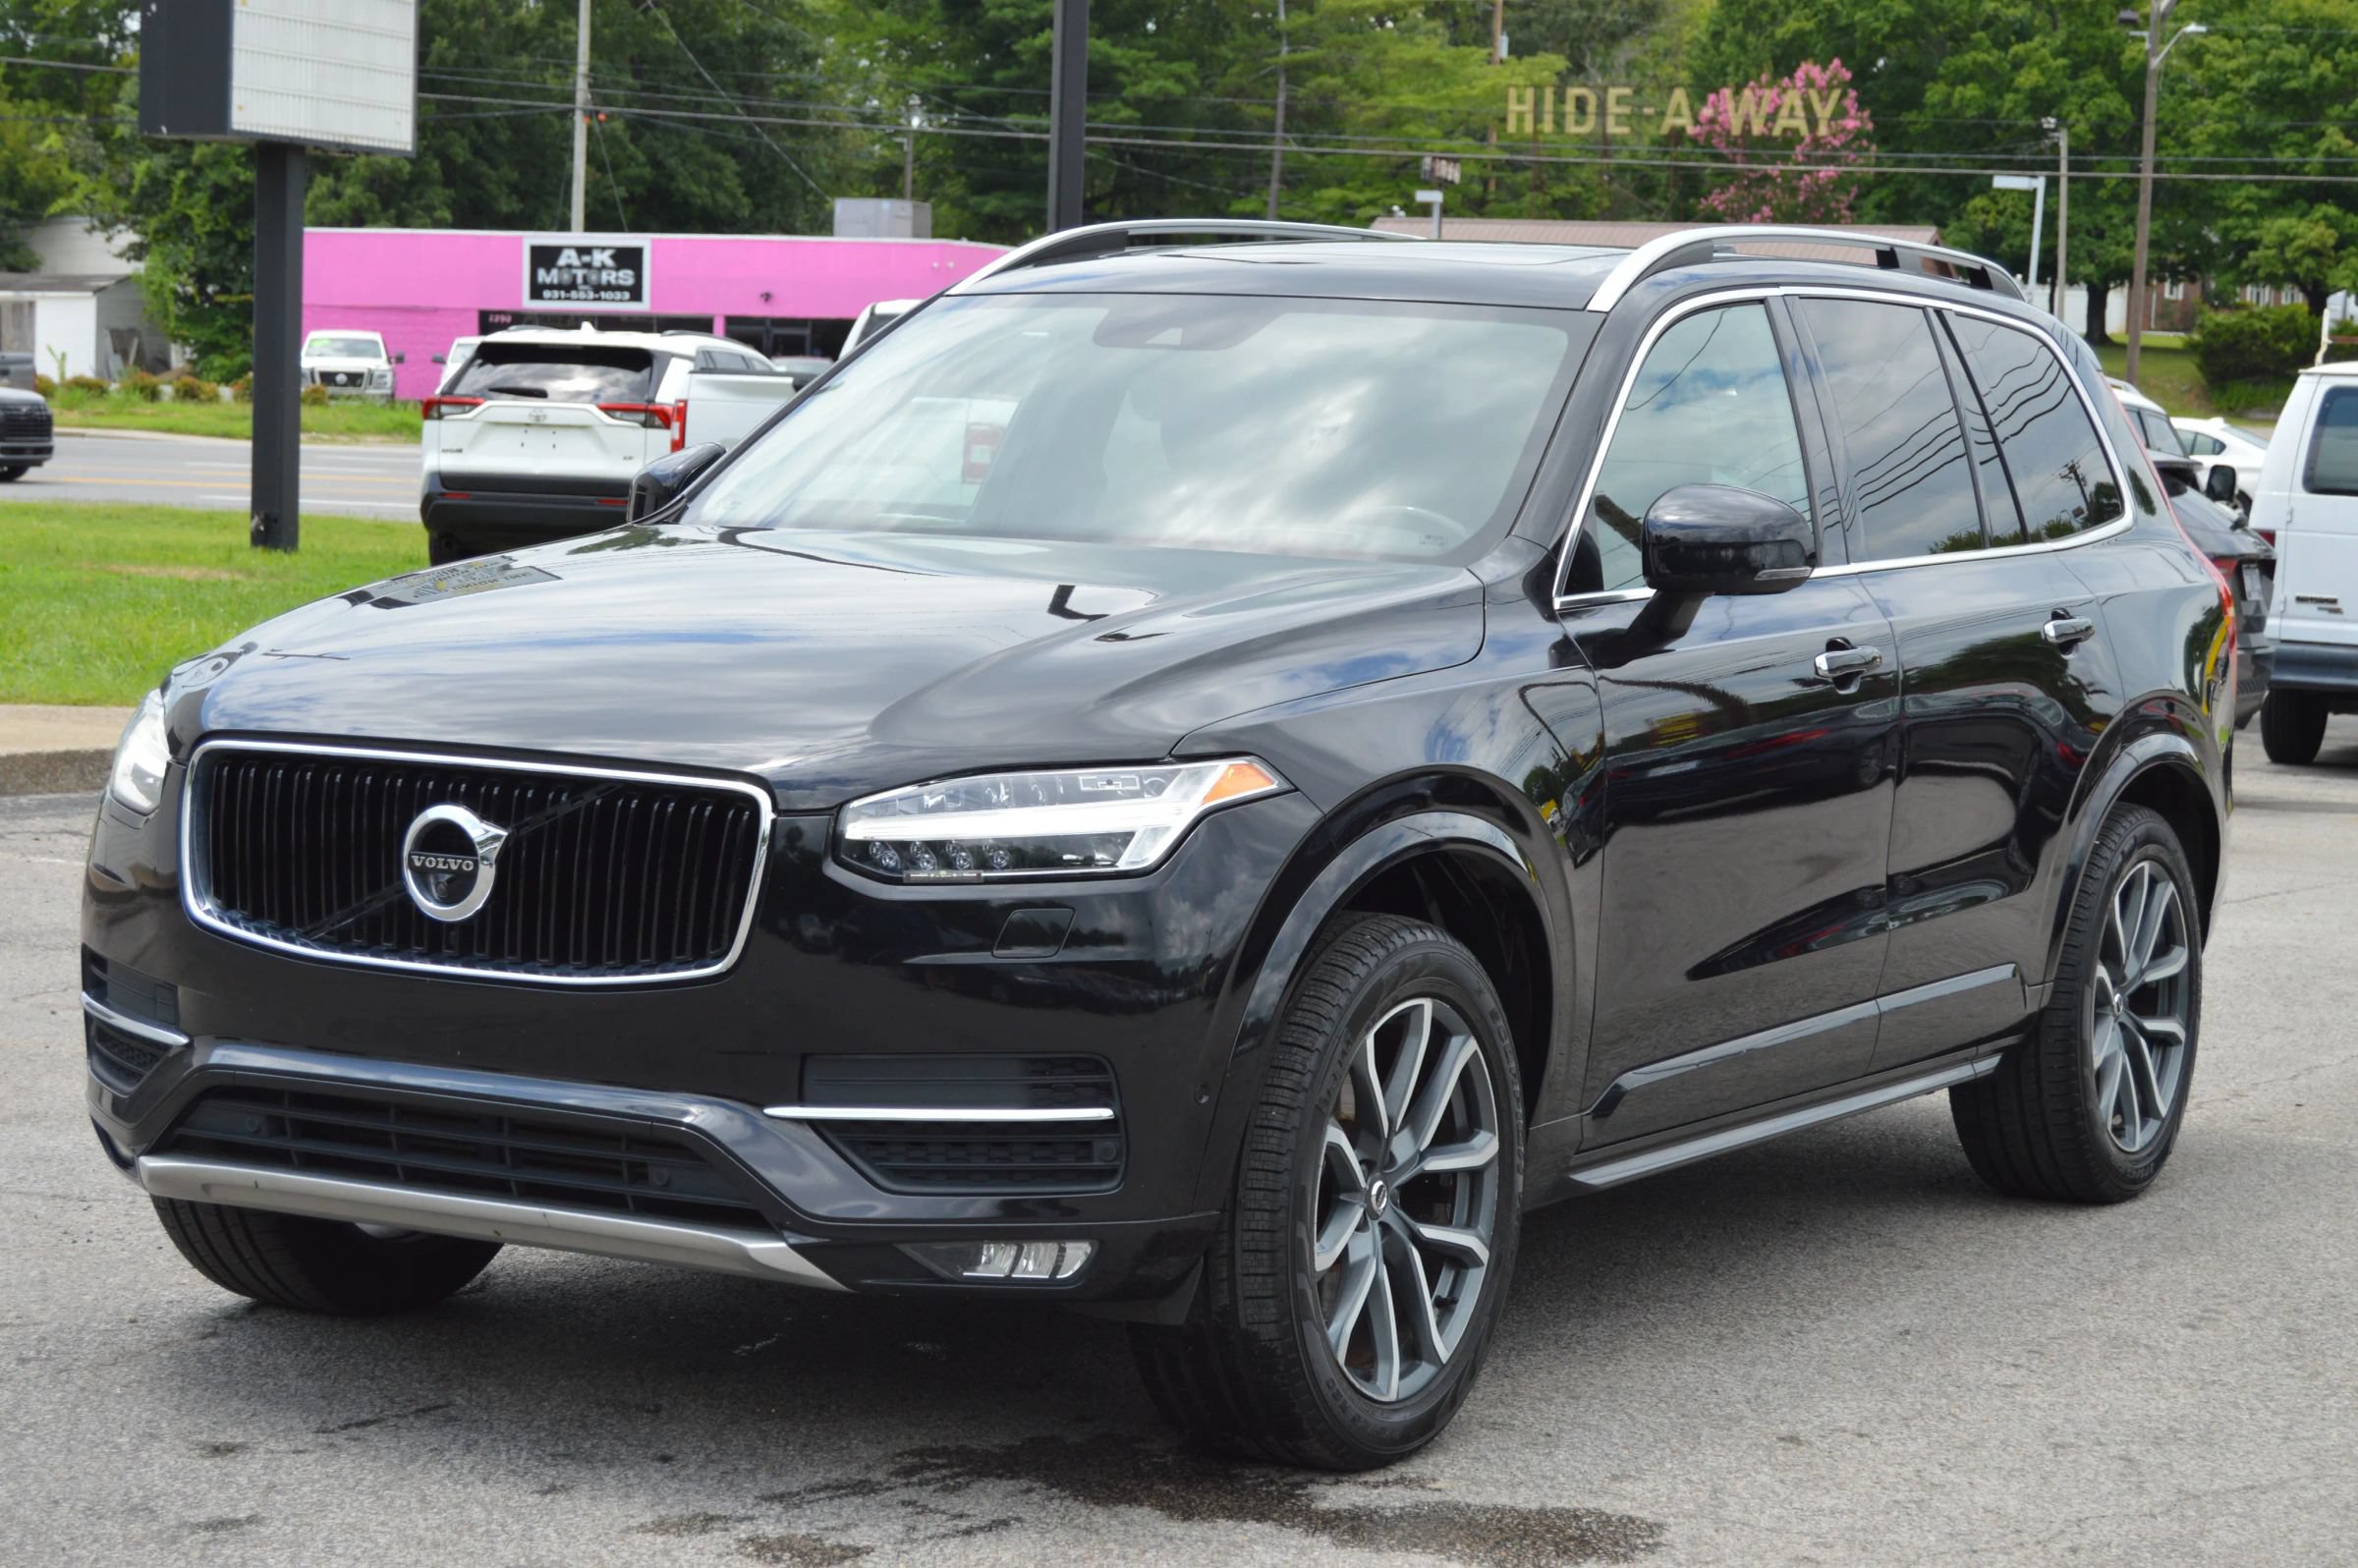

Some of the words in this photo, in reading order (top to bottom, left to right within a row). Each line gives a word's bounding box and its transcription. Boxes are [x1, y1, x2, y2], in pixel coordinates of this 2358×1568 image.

[556, 248, 616, 267] A-K
[537, 267, 635, 286] MOTORS
[411, 855, 475, 871] VOLVO
